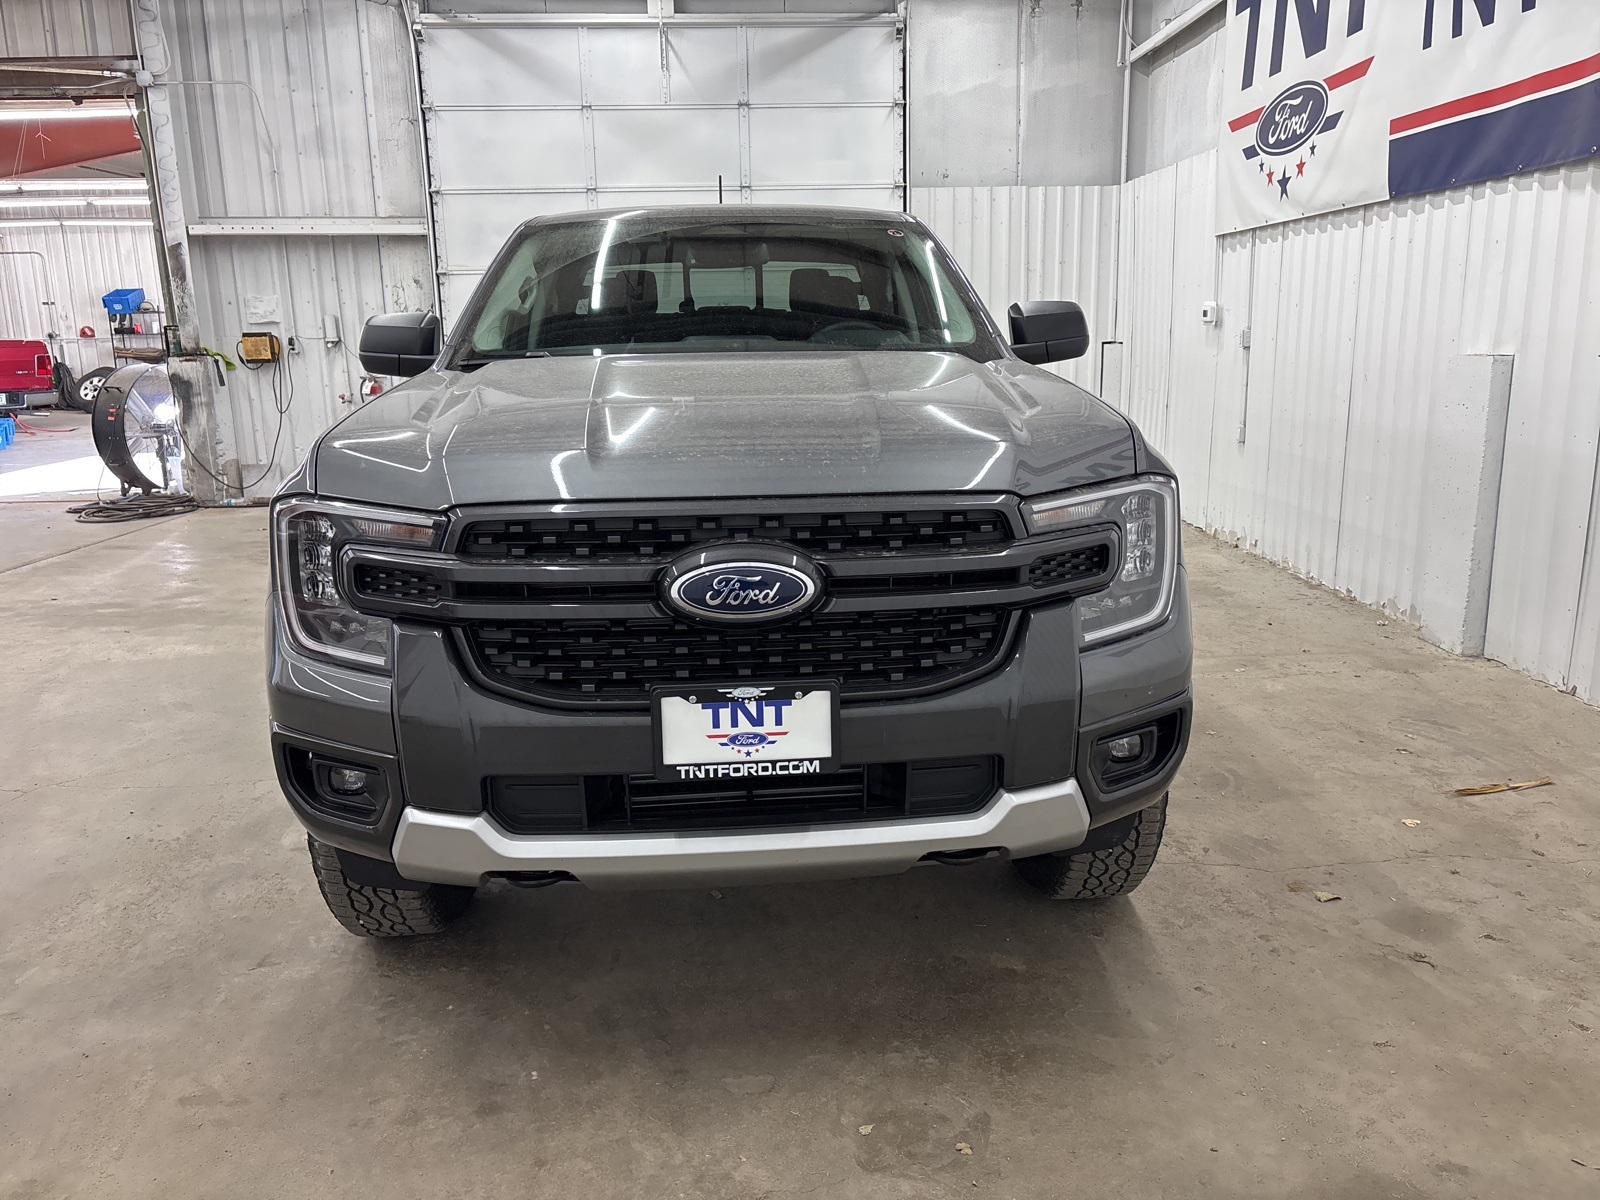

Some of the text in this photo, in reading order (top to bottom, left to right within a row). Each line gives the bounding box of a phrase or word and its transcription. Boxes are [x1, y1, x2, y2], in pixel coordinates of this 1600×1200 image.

[1268, 95, 1313, 145] Ford
[705, 574, 781, 606] Ford
[701, 700, 792, 729] TNT
[735, 734, 760, 745] Ford
[676, 760, 820, 779] TNTFORD.COM
